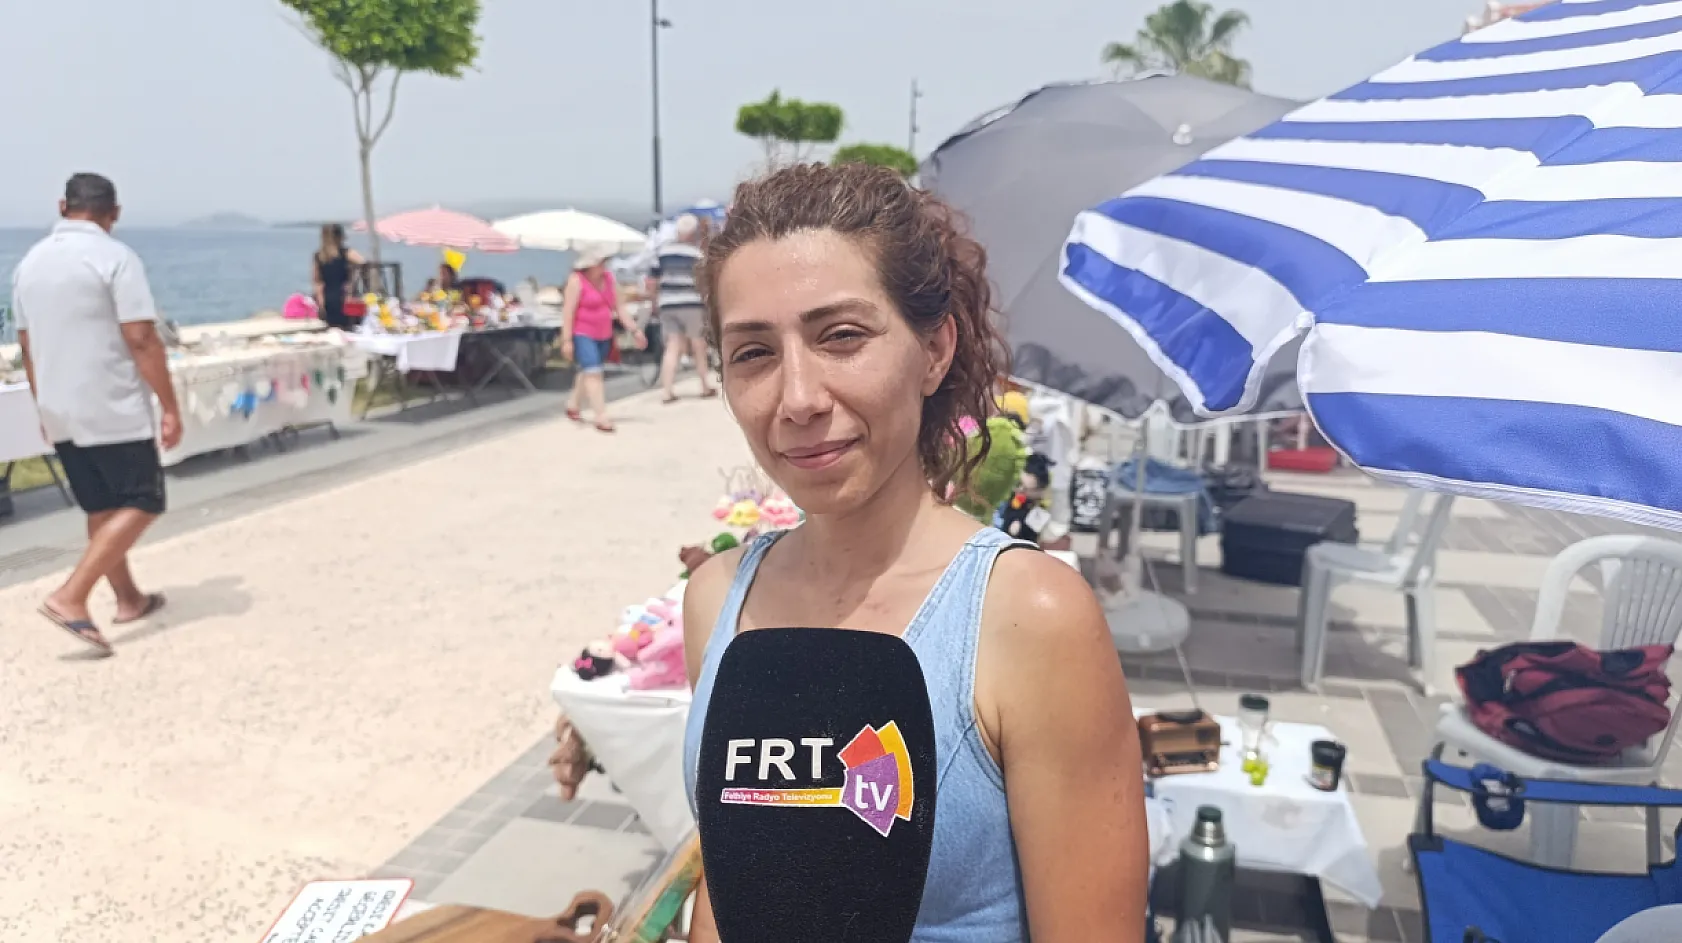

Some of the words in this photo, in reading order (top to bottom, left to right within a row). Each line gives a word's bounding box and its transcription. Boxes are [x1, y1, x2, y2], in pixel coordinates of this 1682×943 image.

[725, 737, 834, 781] FRT
[753, 793, 780, 802] Radyo
[782, 793, 833, 803] Televizyonu
[854, 774, 894, 812] tv
